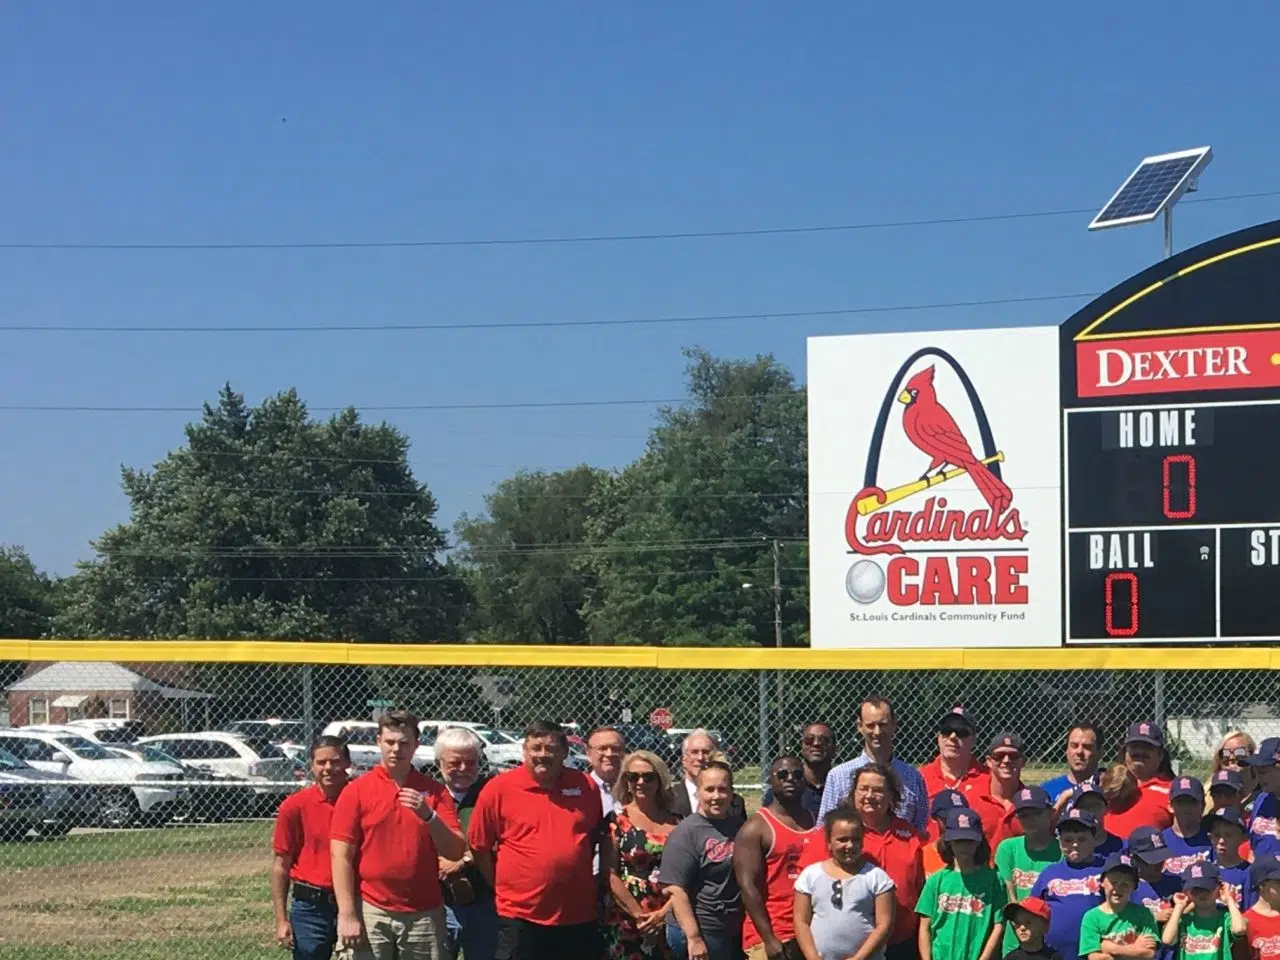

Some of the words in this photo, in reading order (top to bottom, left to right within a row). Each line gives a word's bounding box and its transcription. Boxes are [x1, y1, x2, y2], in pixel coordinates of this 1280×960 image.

[1096, 346, 1250, 387] DEXTER
[1119, 411, 1197, 447] HOME
[1164, 456, 1195, 518] 0
[845, 486, 1028, 556] Cardinals
[1089, 533, 1154, 569] BALL
[887, 556, 1028, 606] CARE
[940, 612, 996, 622] Community
[1106, 573, 1138, 635] 0
